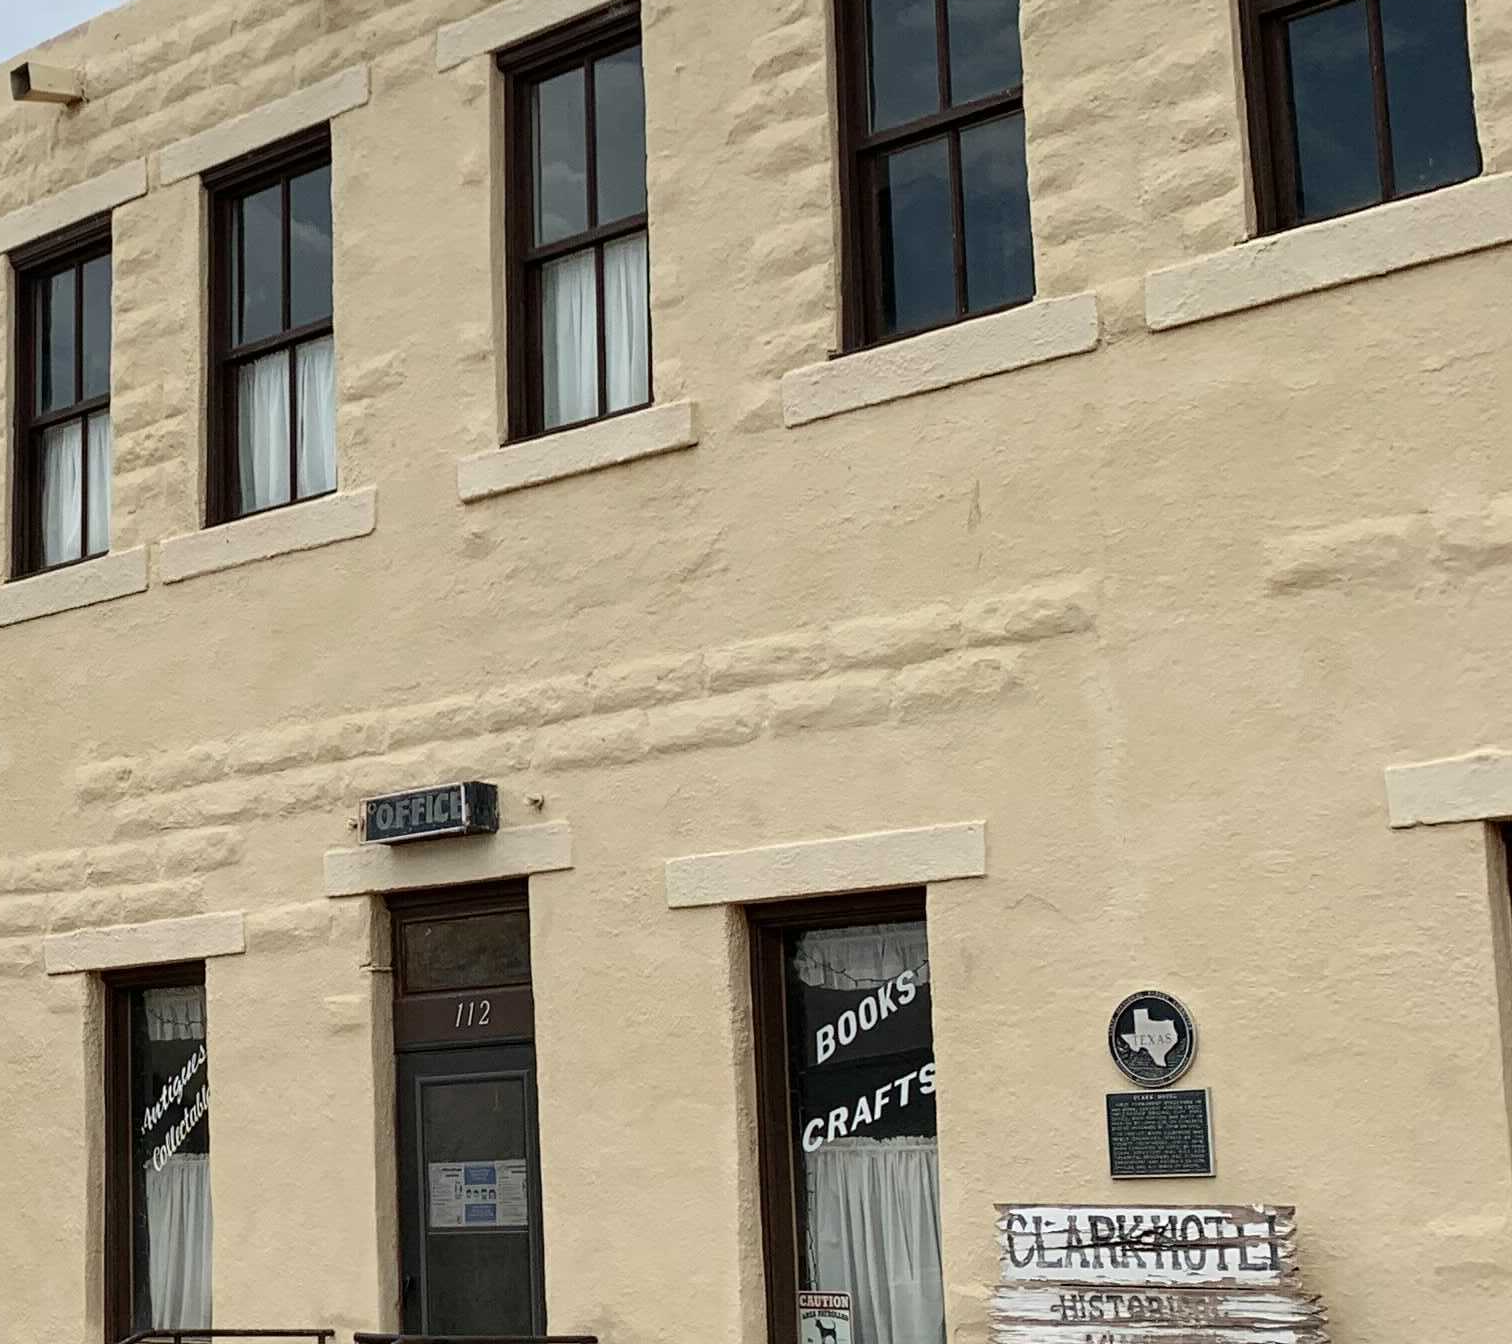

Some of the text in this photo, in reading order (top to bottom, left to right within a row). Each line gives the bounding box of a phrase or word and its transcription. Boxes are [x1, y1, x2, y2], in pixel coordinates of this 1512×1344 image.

[376, 791, 462, 831] OFFICE
[456, 1000, 491, 1027] 112
[816, 970, 916, 1064] BOOKS
[1131, 1032, 1173, 1046] TEXAS
[141, 1044, 206, 1135] Antiques
[802, 1062, 936, 1152] CRAFTS
[1007, 1212, 1147, 1269] CLARK
[799, 1294, 849, 1309] CAUTION
